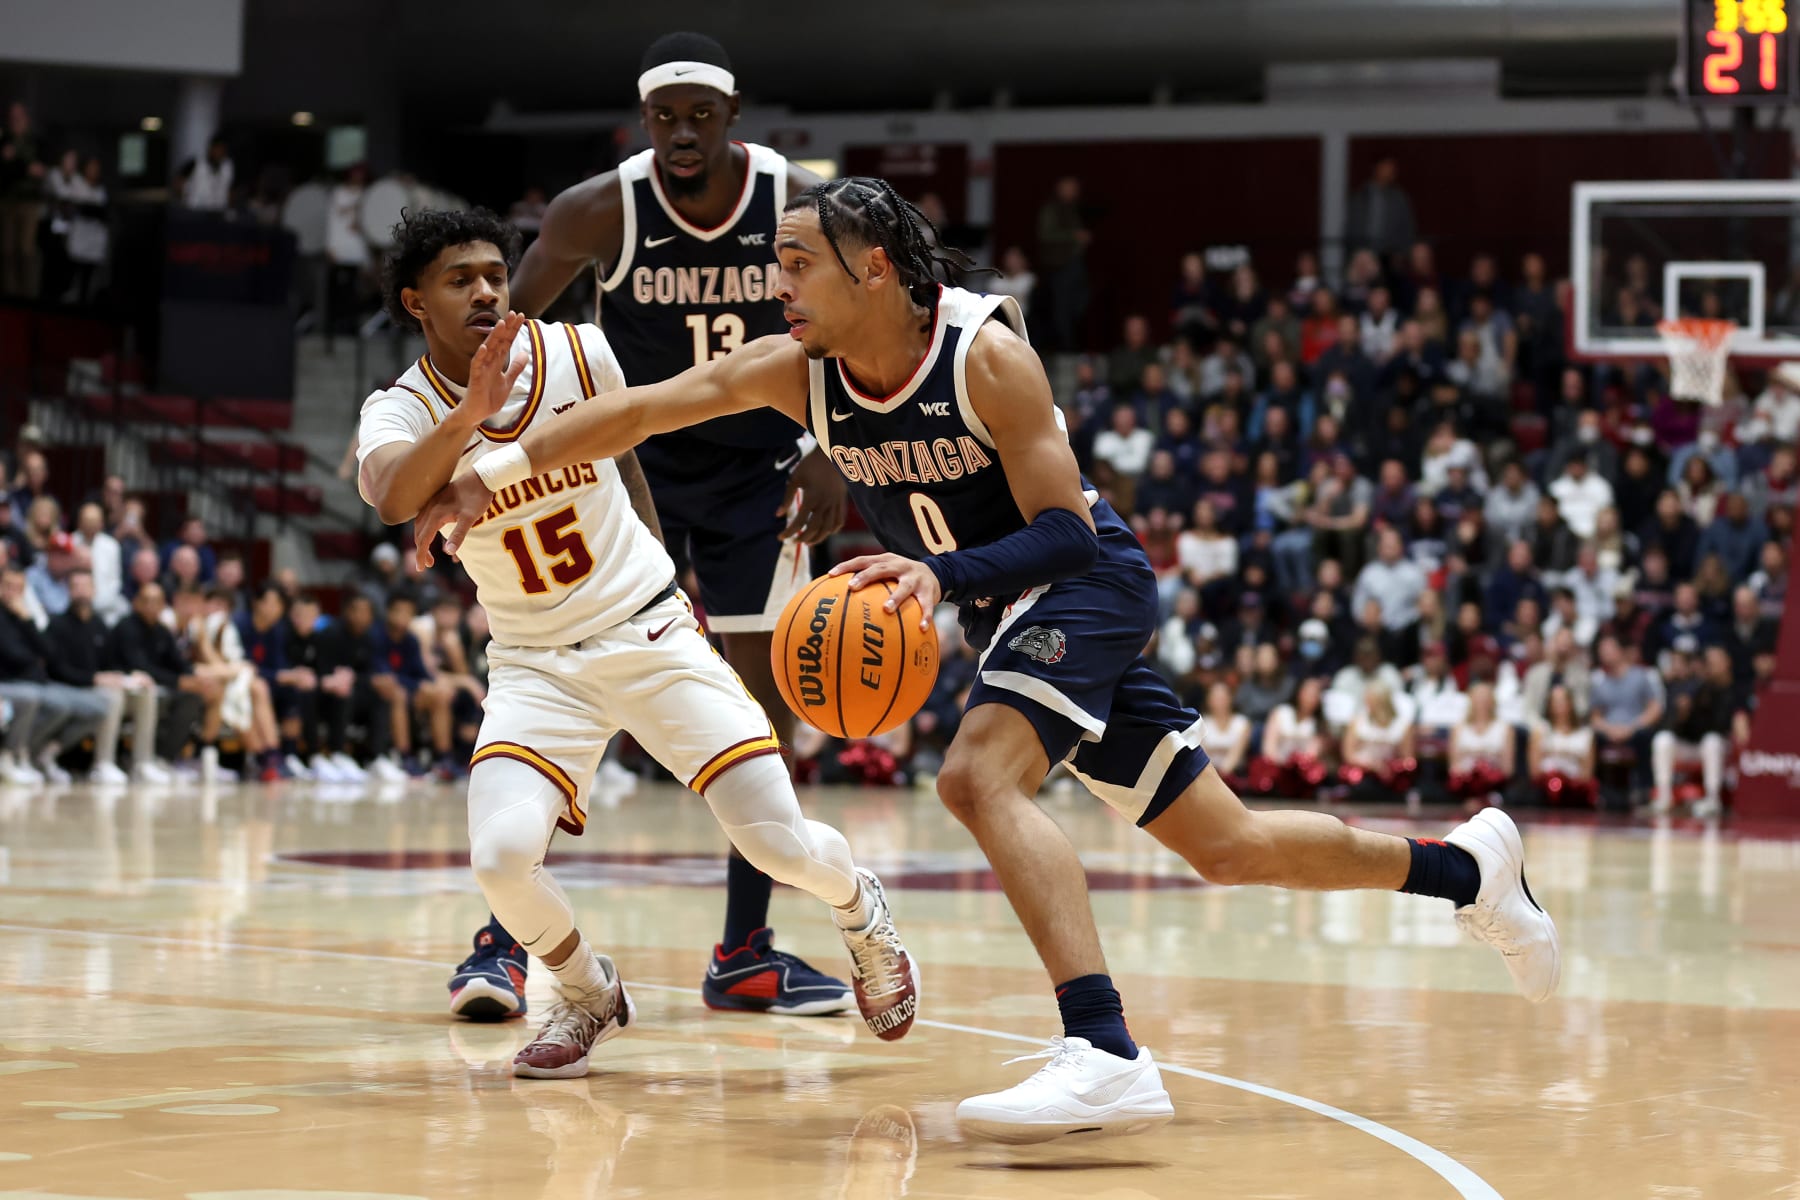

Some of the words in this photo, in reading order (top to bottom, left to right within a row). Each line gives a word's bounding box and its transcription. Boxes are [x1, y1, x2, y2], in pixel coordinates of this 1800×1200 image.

[1703, 30, 1777, 94] 21
[632, 262, 780, 304] GONZAGA
[685, 312, 746, 368] 13
[918, 401, 950, 417] WCC
[830, 435, 992, 487] GONZAGA
[471, 462, 599, 529] RONCOS
[909, 491, 958, 556] 0
[501, 502, 596, 596] 15
[797, 597, 838, 707] Wilson
[860, 622, 885, 691] EVO
[867, 994, 916, 1036] BRONCOS
